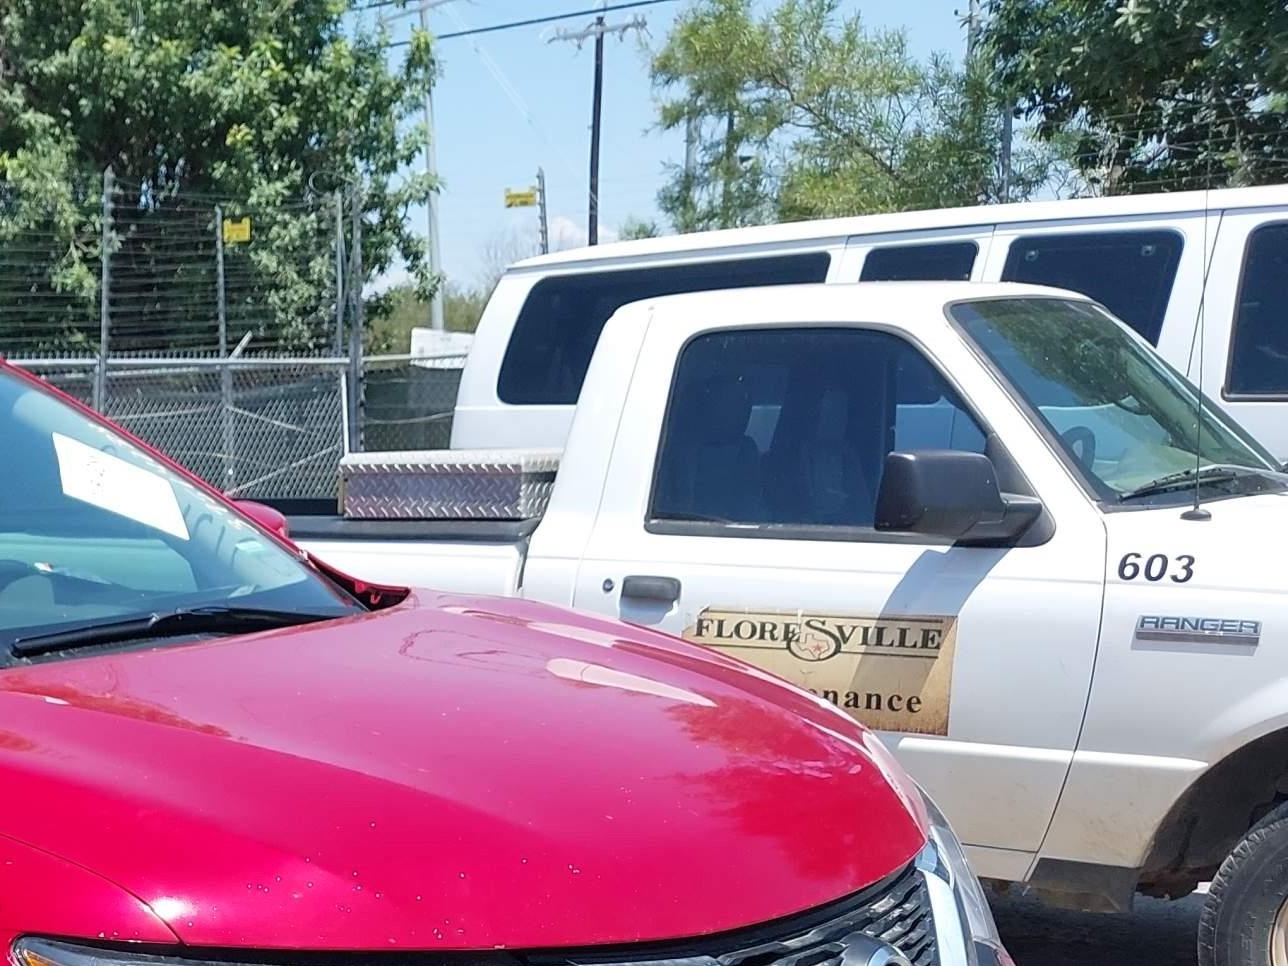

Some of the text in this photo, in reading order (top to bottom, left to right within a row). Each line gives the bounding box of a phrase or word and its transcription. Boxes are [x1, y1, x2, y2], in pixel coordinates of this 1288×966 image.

[1117, 552, 1195, 583] 603
[695, 618, 942, 661] FLORESVILLE
[1139, 616, 1259, 634] RANGER
